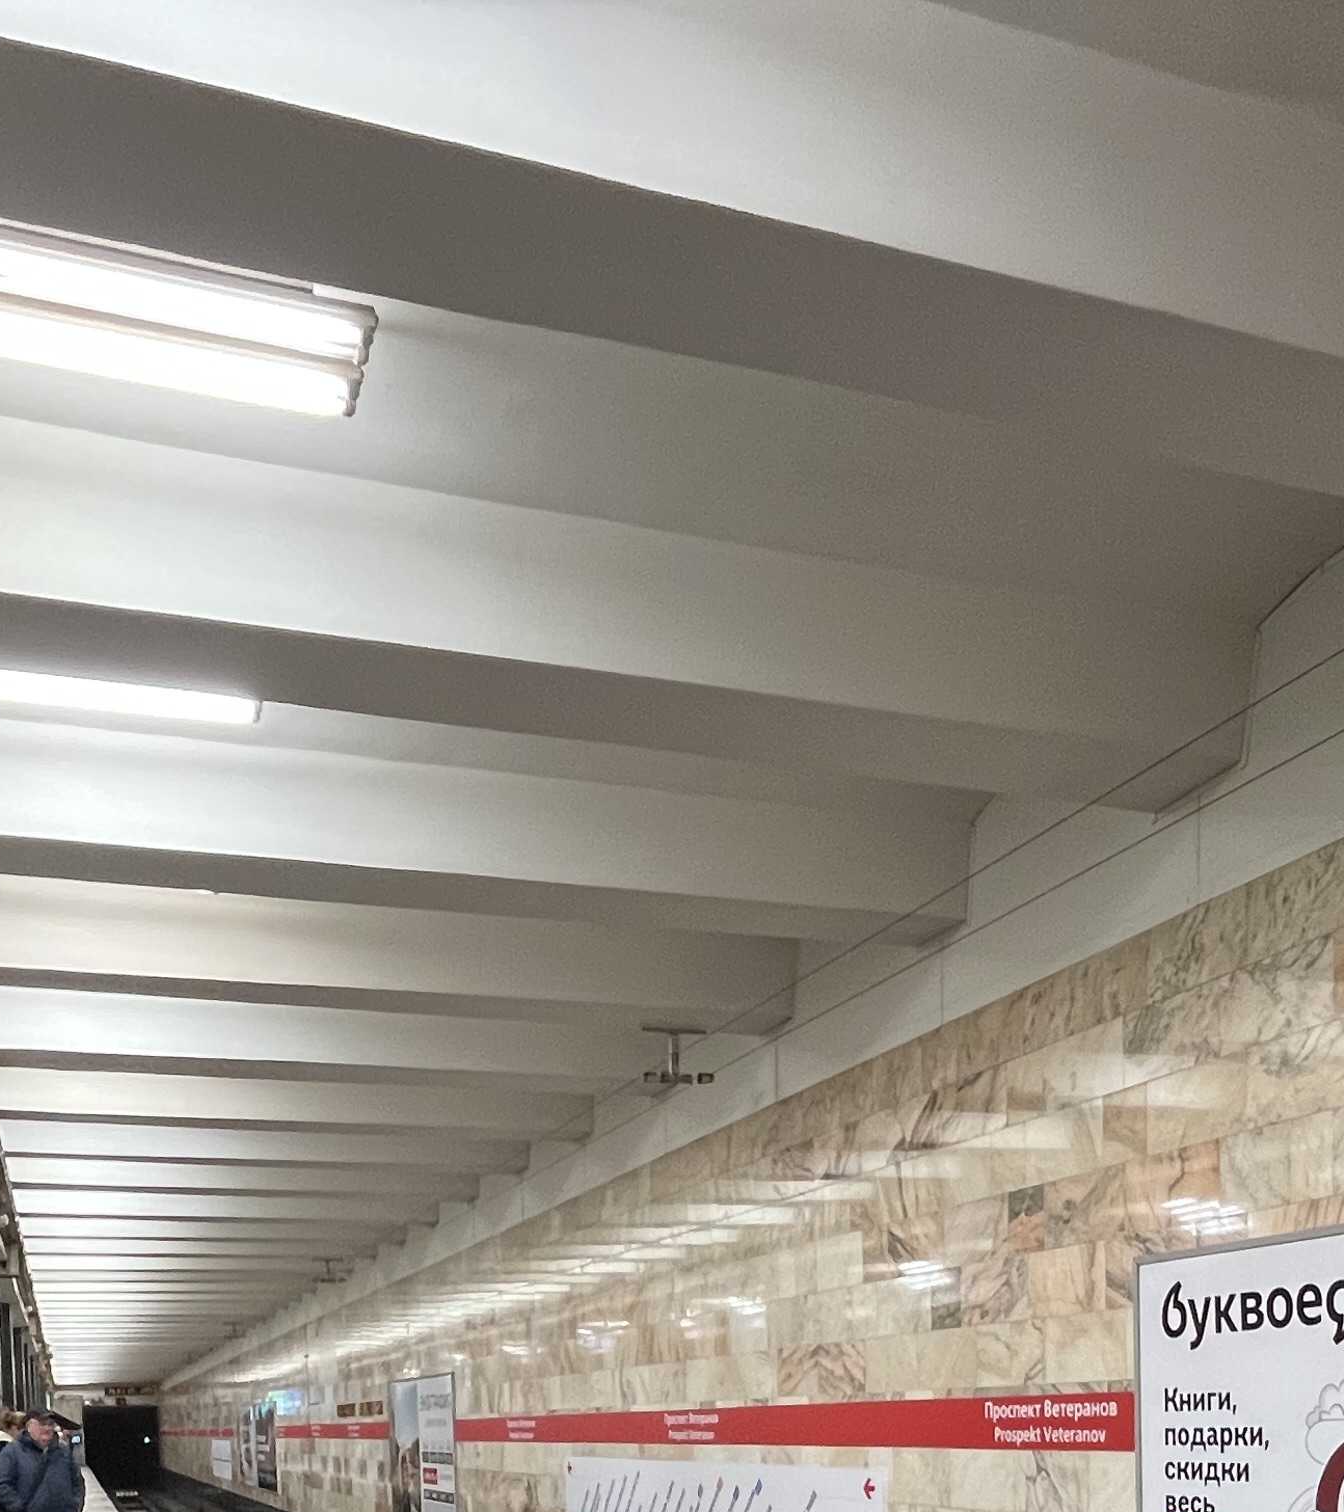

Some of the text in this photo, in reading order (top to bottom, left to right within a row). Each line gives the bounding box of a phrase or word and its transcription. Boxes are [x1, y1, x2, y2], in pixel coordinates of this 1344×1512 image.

[984, 1400, 1118, 1423] Проспект Ветеранов
[1163, 1387, 1238, 1414] Книги,
[994, 1426, 1106, 1446] Prospekt Veteranov
[1164, 1421, 1270, 1450] подарки,
[1164, 1460, 1250, 1484] скидки
